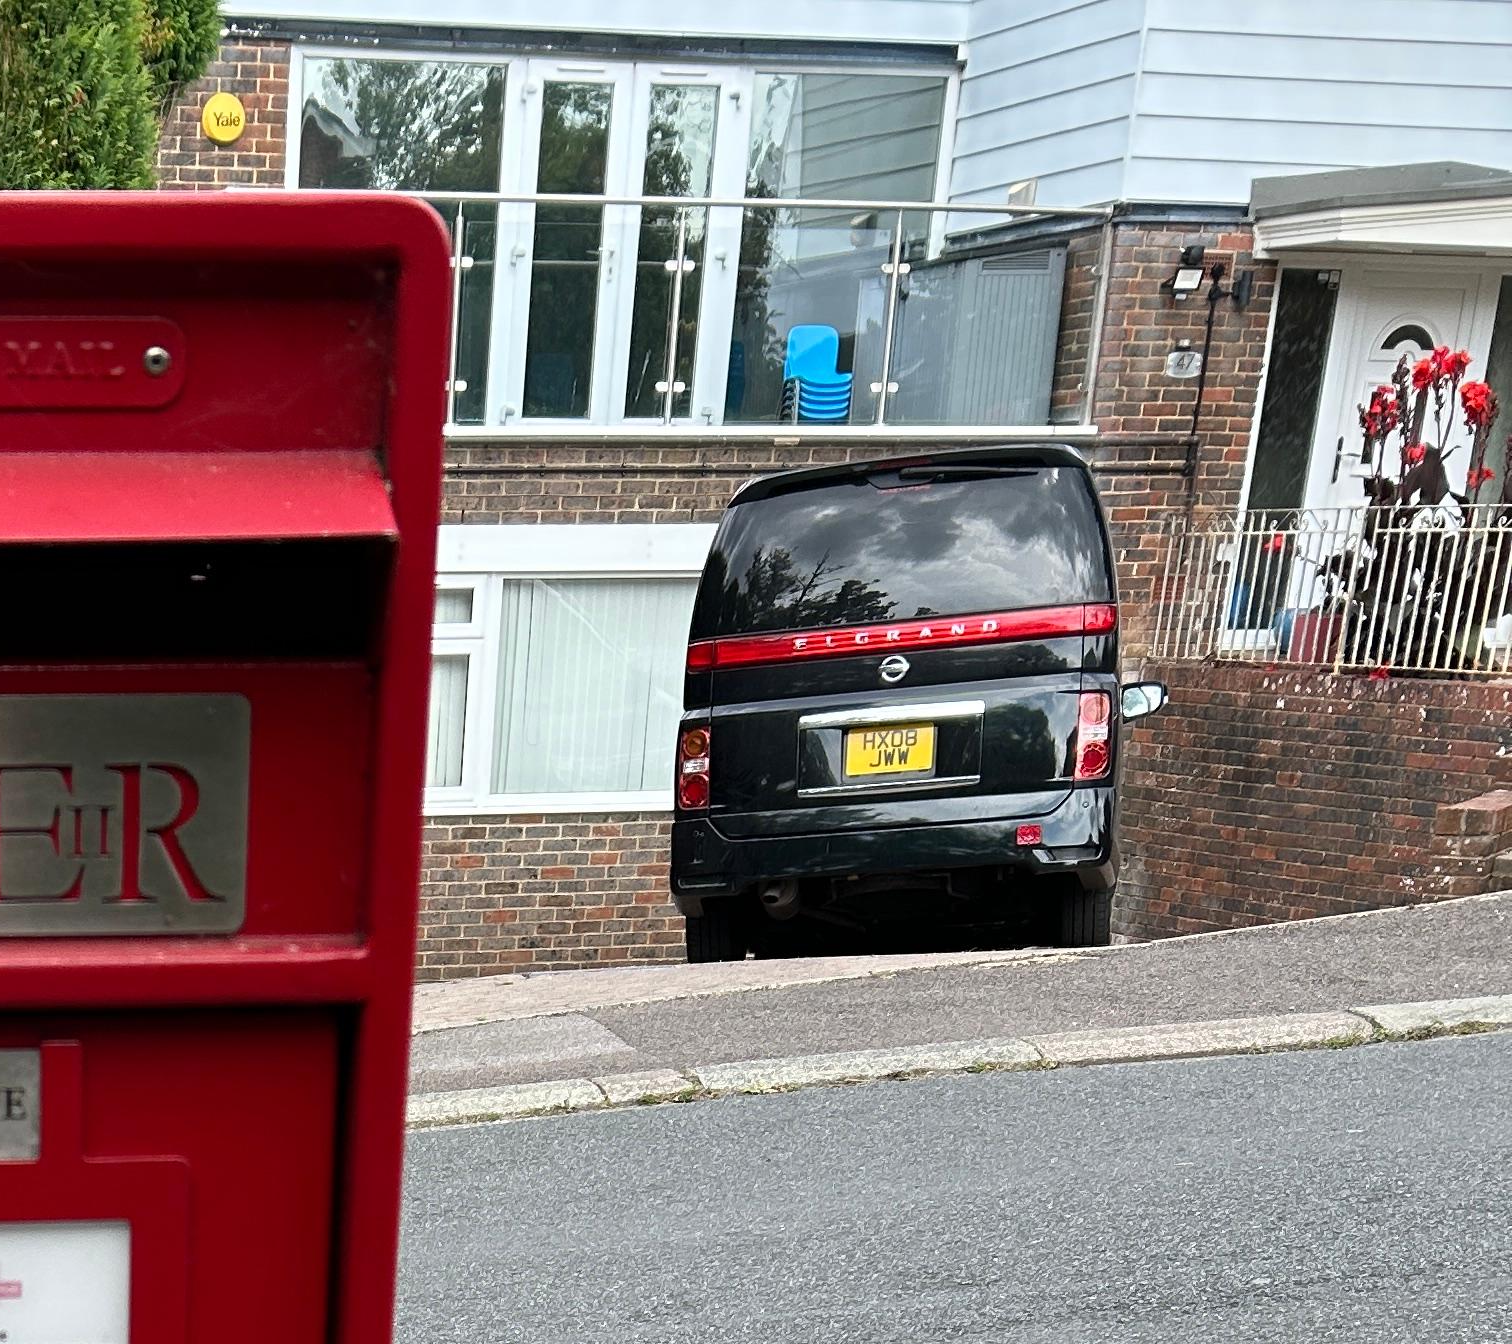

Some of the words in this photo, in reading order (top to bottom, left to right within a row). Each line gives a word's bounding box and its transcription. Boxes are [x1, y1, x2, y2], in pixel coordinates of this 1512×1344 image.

[213, 111, 241, 127] Yale
[3, 338, 127, 377] MAIL
[1176, 353, 1196, 371] 47
[793, 619, 999, 651] ELGRAND
[863, 729, 918, 751] HX08
[869, 747, 910, 768] JWW
